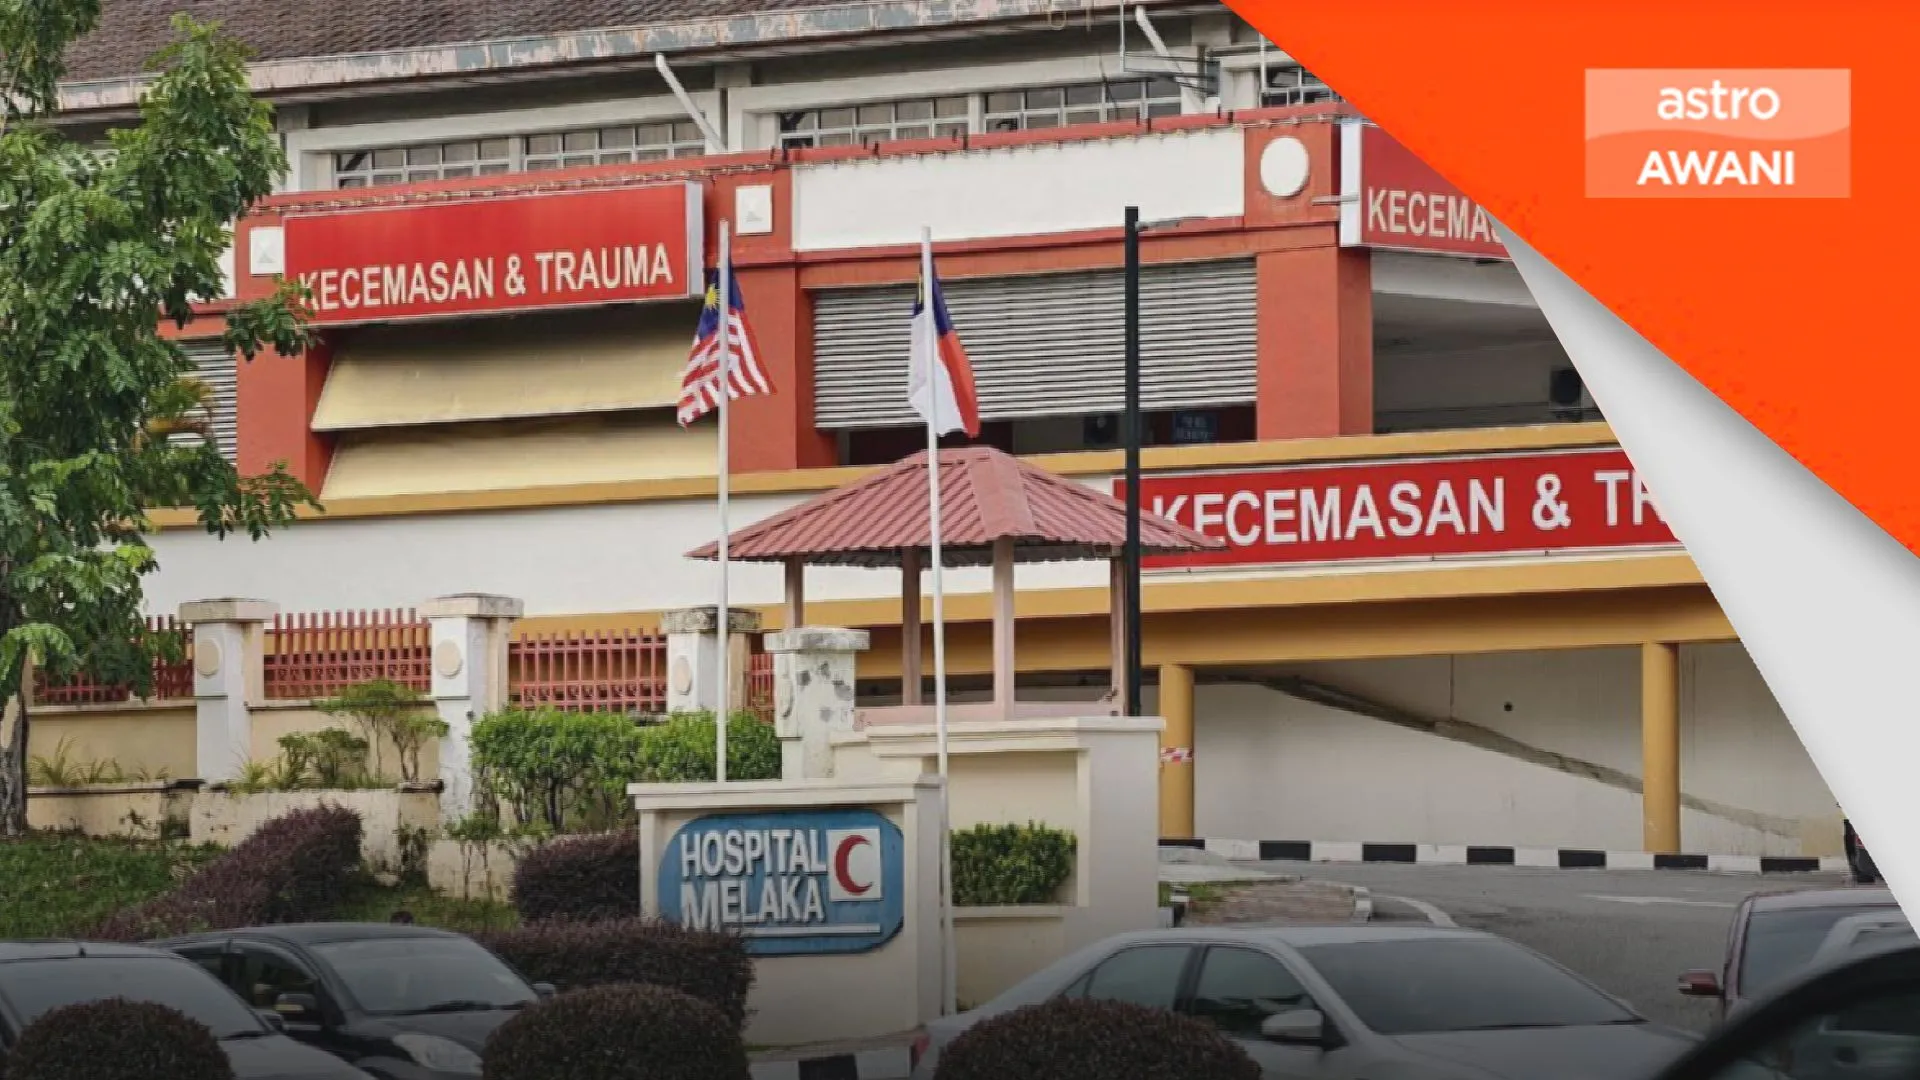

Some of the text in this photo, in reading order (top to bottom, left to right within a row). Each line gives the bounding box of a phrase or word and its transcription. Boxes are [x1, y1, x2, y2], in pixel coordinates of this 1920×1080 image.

[299, 243, 673, 310] KECEMASAN & TRAUMA
[1532, 473, 1572, 530] &
[680, 829, 827, 877] HOSPITAL
[680, 876, 824, 932] MELAKA
